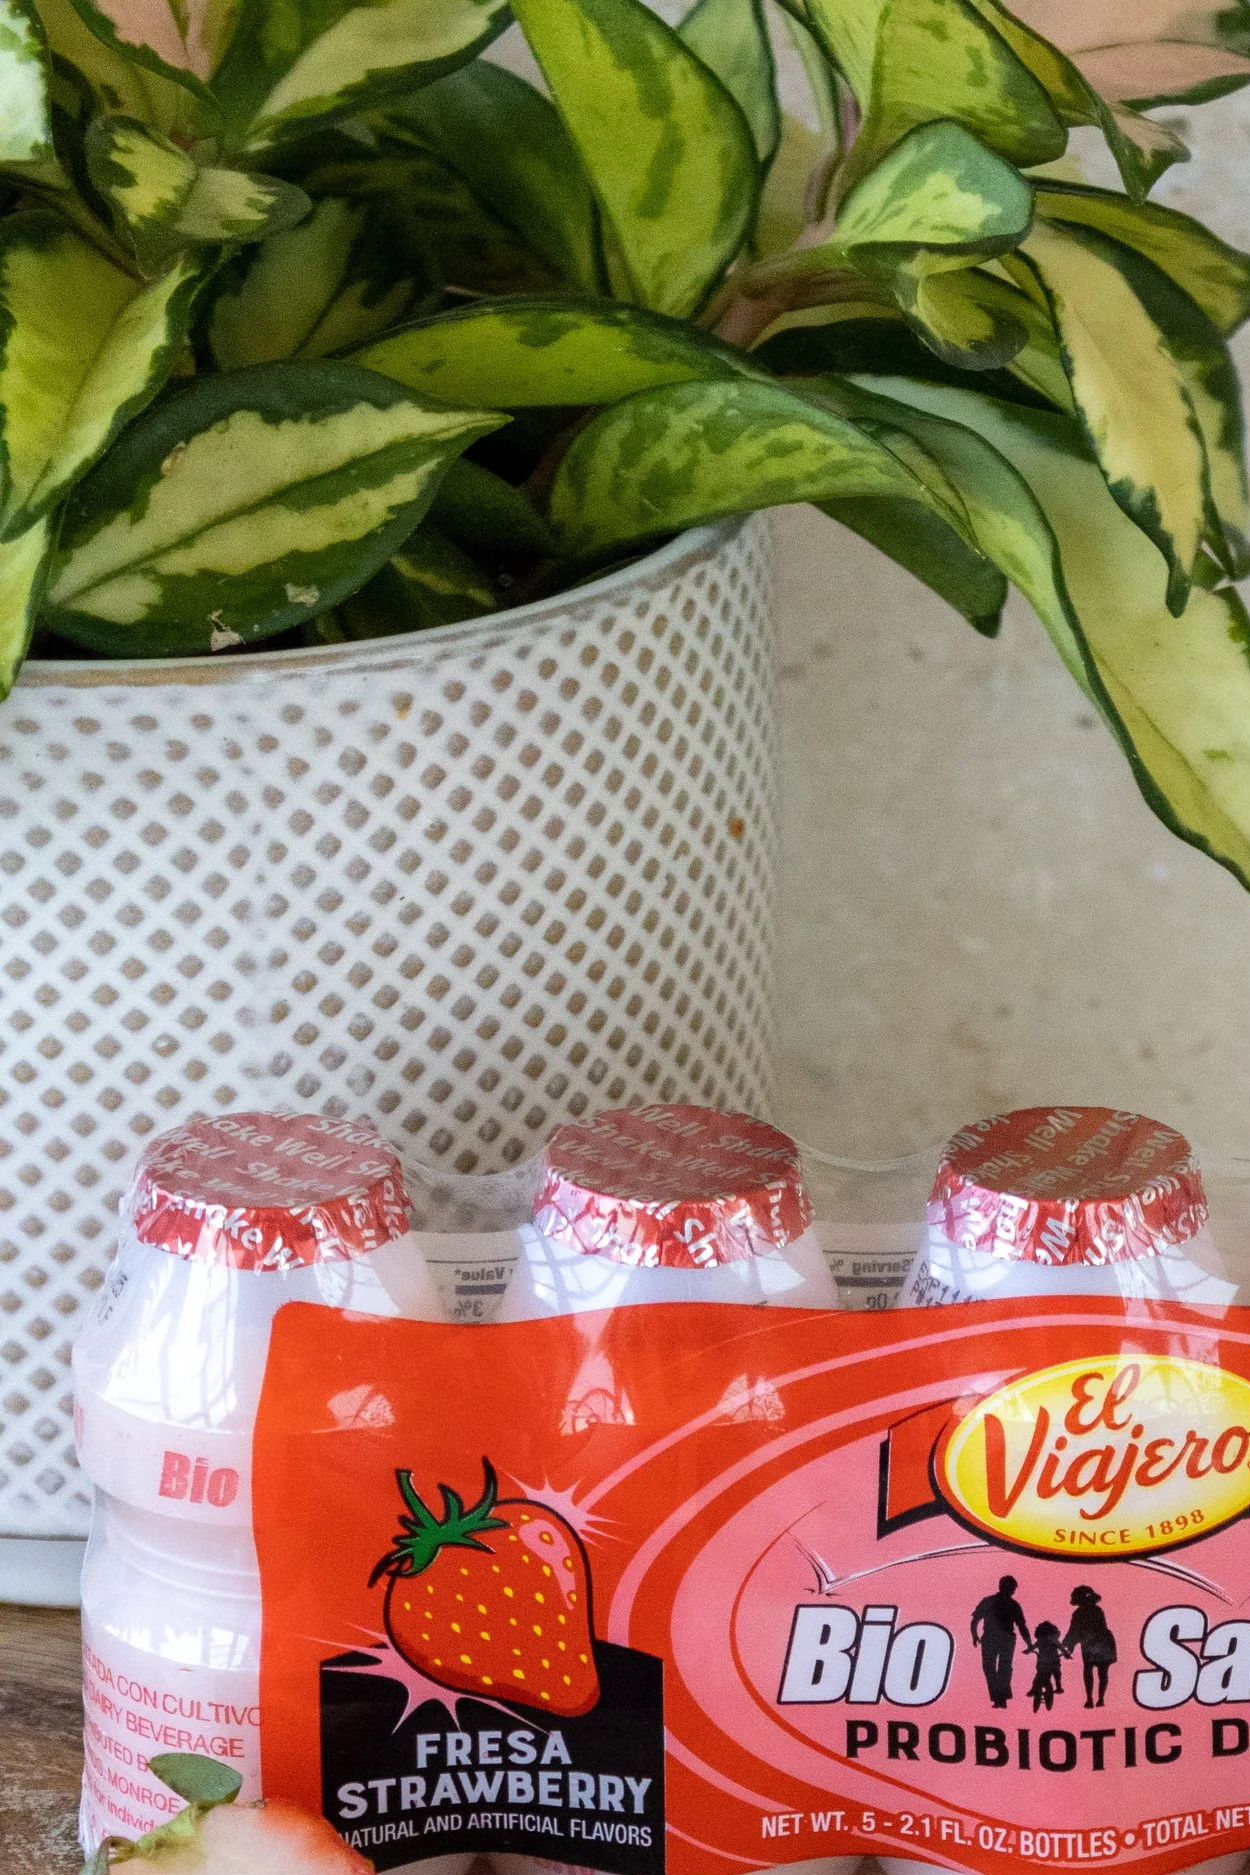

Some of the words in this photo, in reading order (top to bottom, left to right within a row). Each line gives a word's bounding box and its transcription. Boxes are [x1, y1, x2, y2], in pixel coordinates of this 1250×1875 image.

[275, 1137, 351, 1170] Well
[1064, 1363, 1142, 1436] El
[159, 1450, 240, 1508] Bio
[1053, 1528, 1132, 1546] SINCE
[1145, 1508, 1205, 1540] 1898
[777, 1603, 956, 1708] Bio
[117, 1675, 157, 1710] CON
[126, 1710, 246, 1759] BEVERAGE
[416, 1730, 573, 1769] FRESA
[845, 1719, 1183, 1773] PROBIOTIC
[107, 1767, 180, 1815] MONROE
[337, 1770, 652, 1819] STRAWBERRY
[424, 1814, 463, 1836] AND
[467, 1812, 564, 1837] ARTIFICIAL
[570, 1818, 653, 1848] FLAVORS
[761, 1813, 804, 1838] NET
[811, 1811, 849, 1833] WT.
[862, 1811, 875, 1832] 5
[900, 1814, 932, 1838] 2.1
[941, 1820, 973, 1846] FL.
[979, 1825, 1014, 1853] OZ.
[1020, 1829, 1117, 1859] BOTTLES
[1143, 1813, 1209, 1847] TOTAL
